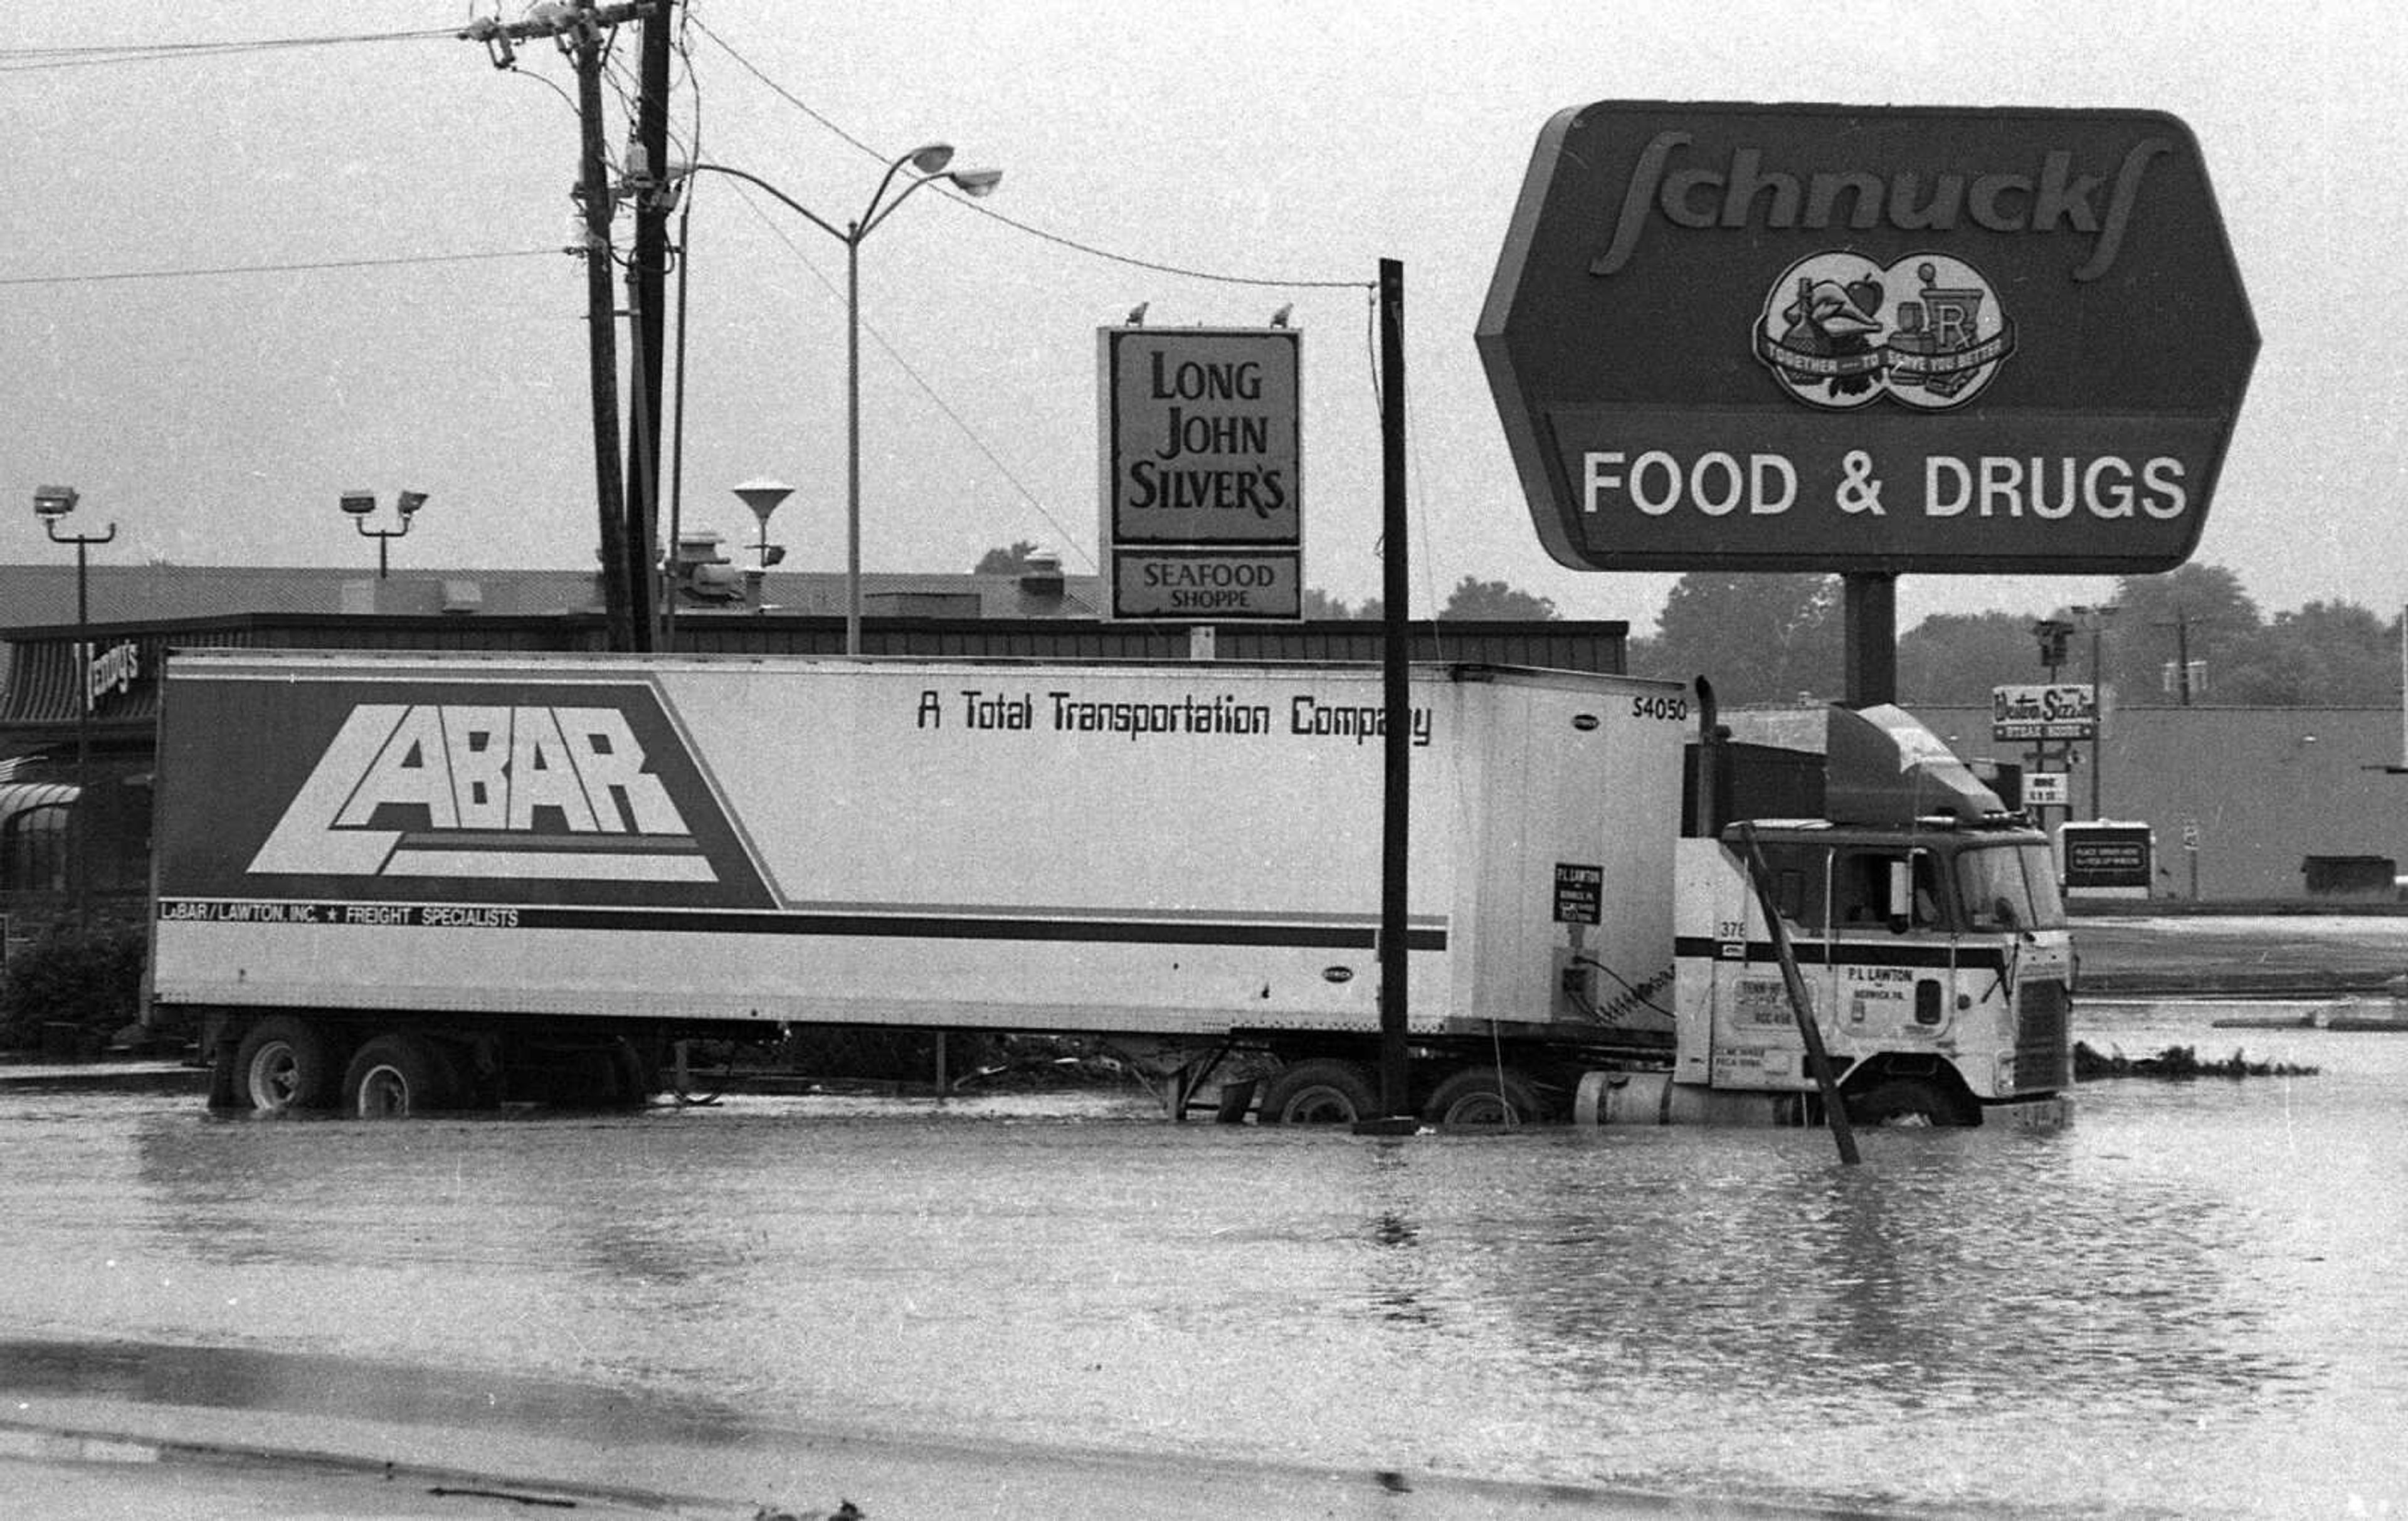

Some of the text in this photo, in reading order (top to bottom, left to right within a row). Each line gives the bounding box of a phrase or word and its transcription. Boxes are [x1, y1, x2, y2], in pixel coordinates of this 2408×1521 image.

[1588, 130, 2171, 282] Schnucks
[1151, 351, 1262, 400] LONG
[1767, 342, 1838, 374] TOGETHER
[1862, 352, 1879, 369] TO
[1956, 339, 2002, 364] BETTER
[1156, 406, 1269, 460] JOHN
[1129, 460, 1284, 519] SILVER'S
[1584, 450, 2186, 518] FOOD & DRUGS
[1144, 562, 1275, 587] SEAFOOD
[1171, 589, 1251, 609] SHOPPE
[917, 690, 1432, 746] A Total Transportation Compay
[1633, 697, 1687, 720] S4050
[346, 907, 411, 925] FREIGHT
[421, 907, 519, 928] SPECIALISTS
